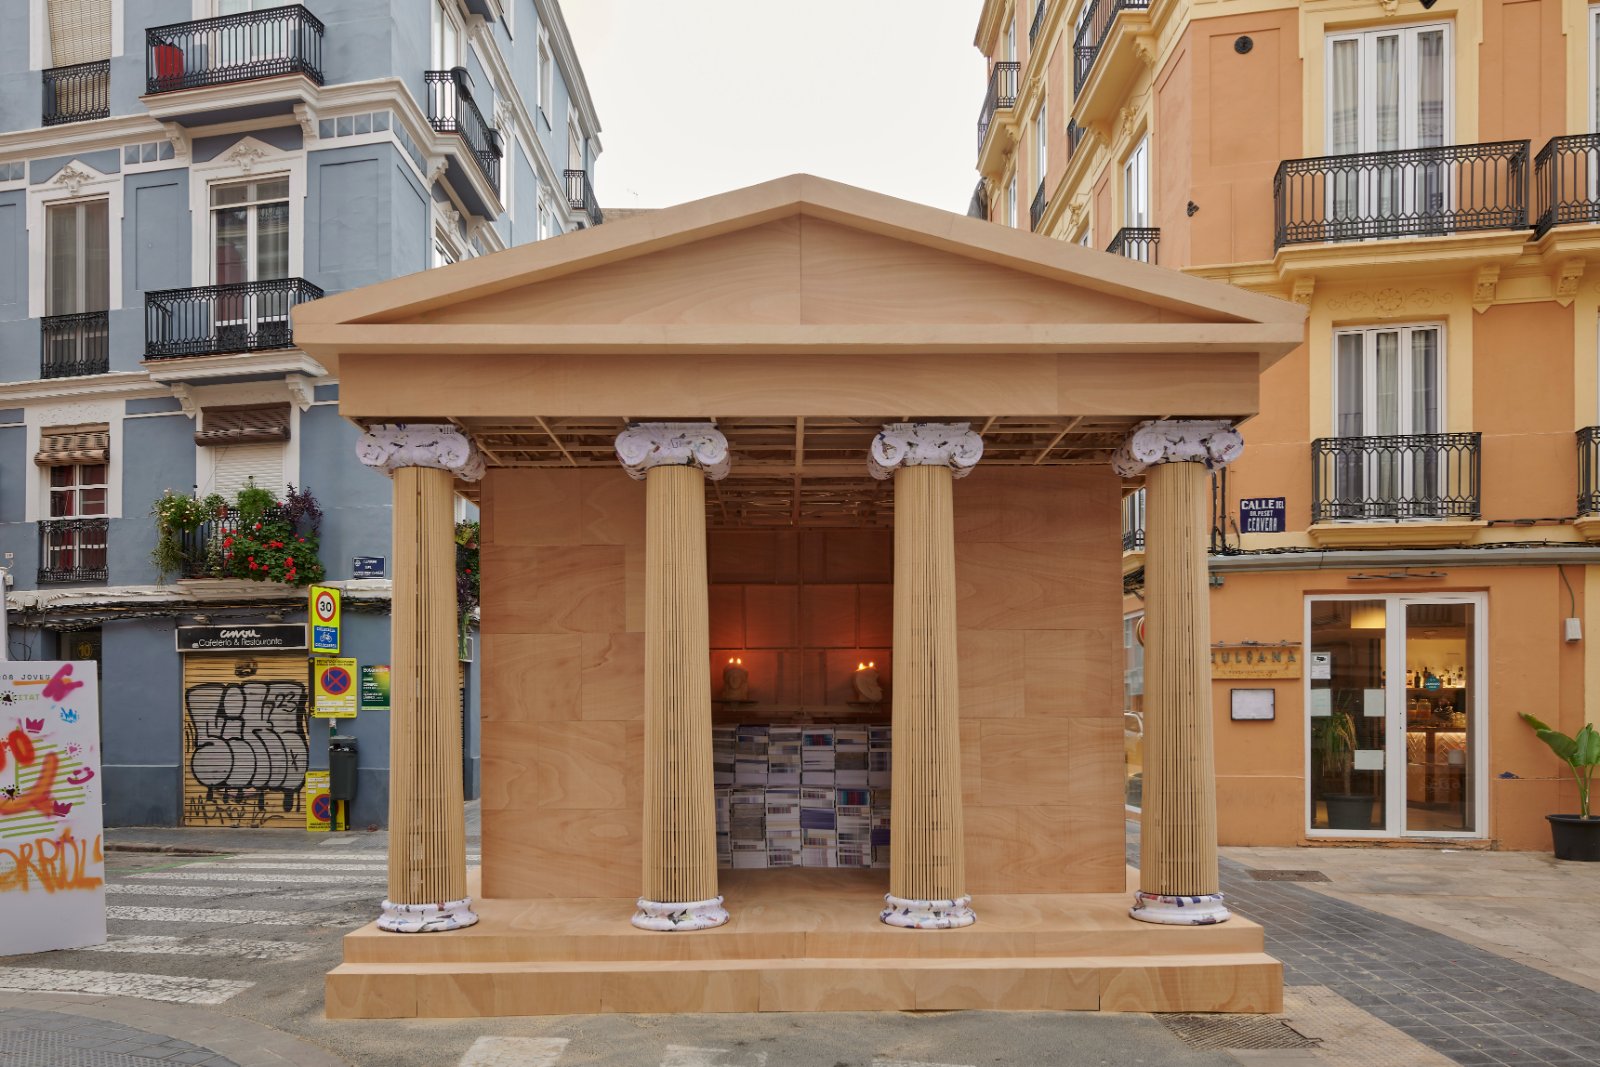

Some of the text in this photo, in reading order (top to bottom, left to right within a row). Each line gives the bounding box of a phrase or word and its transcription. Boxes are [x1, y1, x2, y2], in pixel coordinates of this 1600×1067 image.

[1241, 500, 1275, 510] CALLE
[1247, 517, 1278, 532] CERVERA
[319, 601, 332, 613] 30
